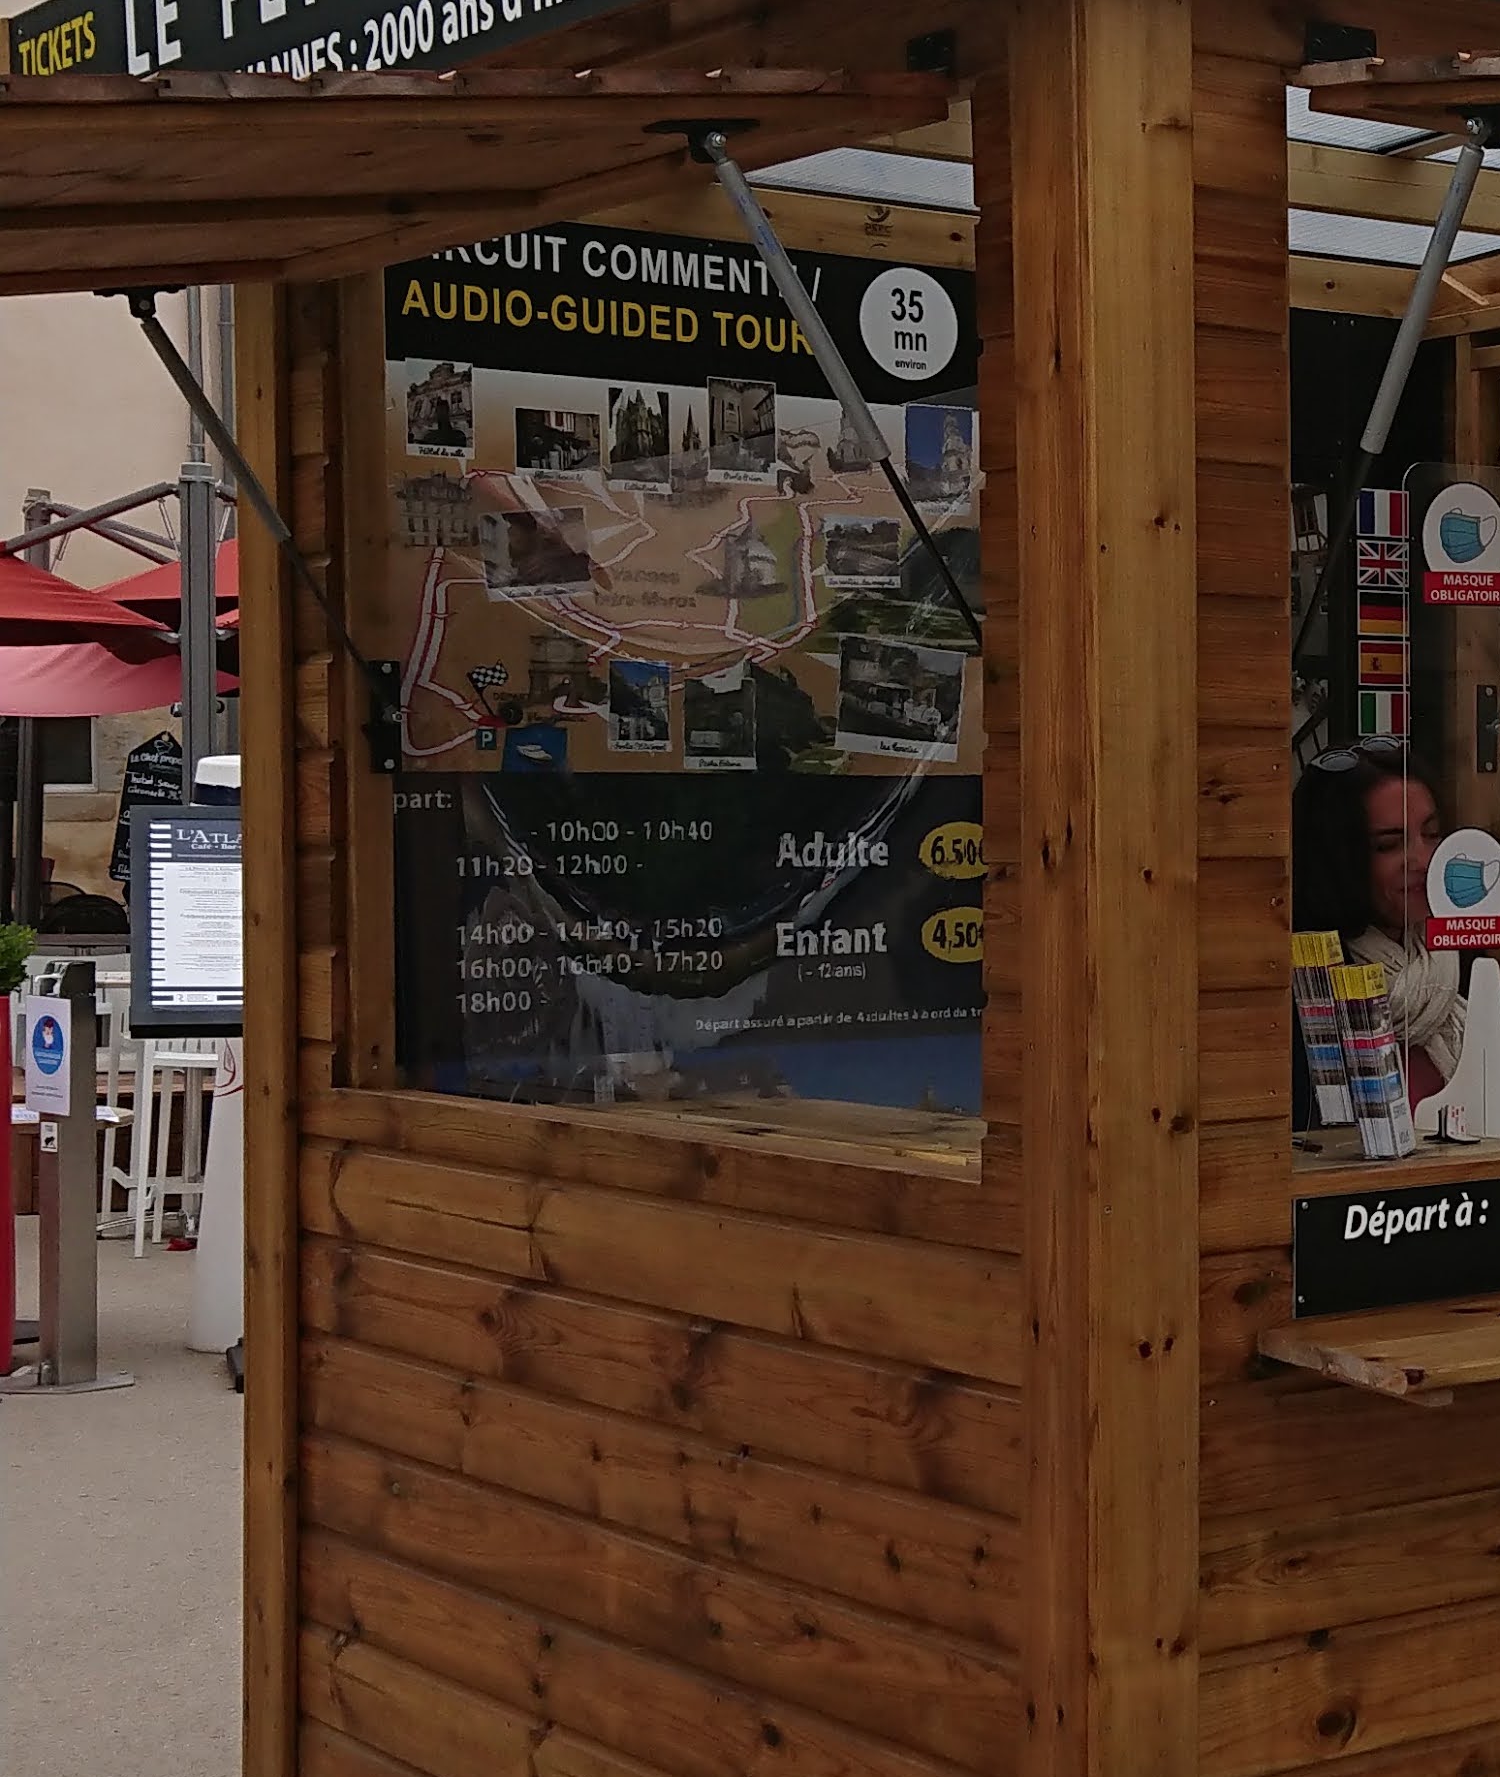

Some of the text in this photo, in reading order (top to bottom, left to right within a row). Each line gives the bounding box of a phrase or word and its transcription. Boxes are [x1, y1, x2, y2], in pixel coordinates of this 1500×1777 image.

[18, 10, 96, 77] TICKETS
[582, 240, 798, 299] COMMENT
[401, 279, 816, 355] AUDIO-GUIDED TOUR
[890, 288, 924, 324] 35
[894, 330, 928, 353] mn
[895, 358, 927, 371] environ
[1443, 573, 1494, 587] MASQUE
[481, 731, 494, 748] P
[547, 821, 619, 843] 10h00
[643, 820, 713, 841] 10h40
[776, 830, 889, 868] Adulte
[456, 855, 533, 878] 11h20
[556, 854, 628, 877] 12h00
[456, 922, 534, 946] 14h00
[556, 919, 630, 942] 14h40
[653, 917, 723, 939] 15h20
[776, 918, 888, 957] Enfant
[1445, 918, 1497, 931] MASQUE
[456, 956, 531, 980] 16h00
[556, 953, 631, 976] 16h40
[653, 951, 723, 973] 17h20
[456, 991, 531, 1014] 18h00
[836, 1011, 852, 1024] de
[1343, 1197, 1451, 1245] Départ
